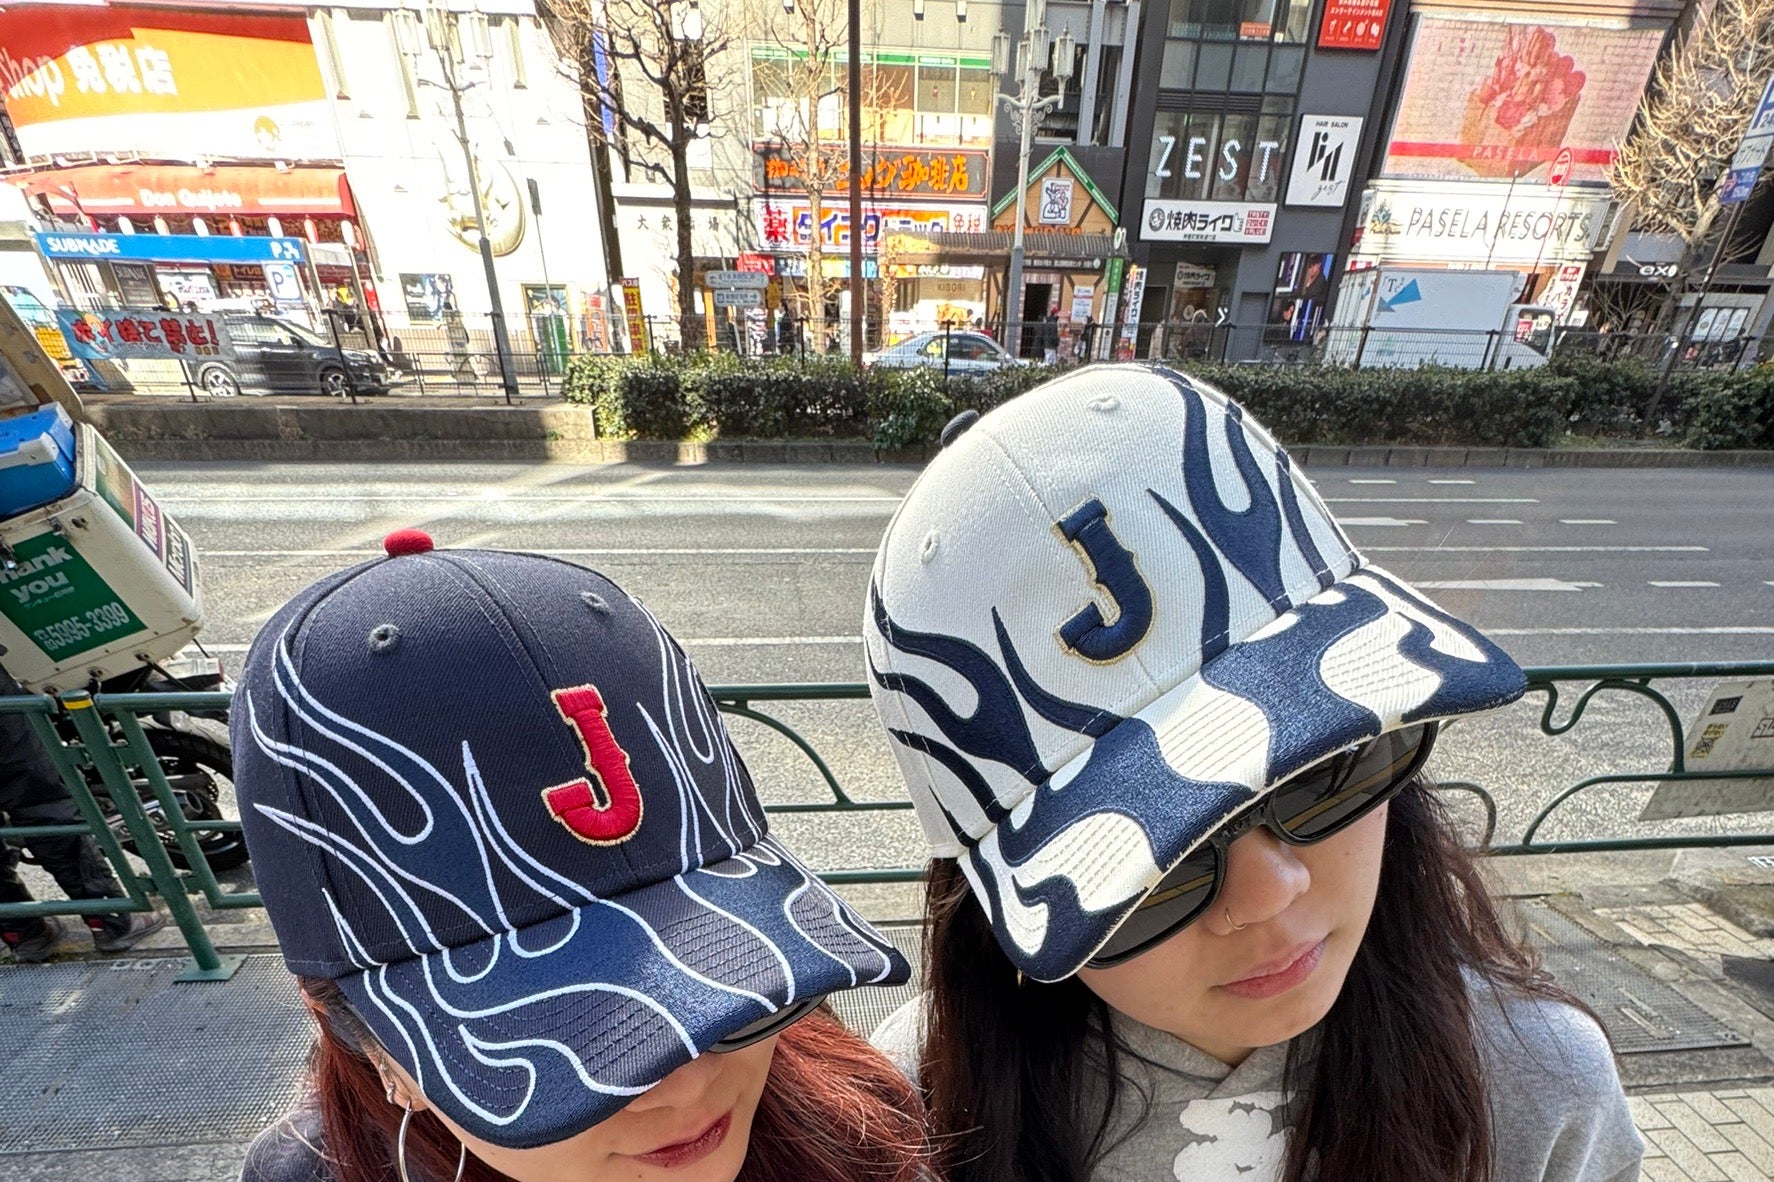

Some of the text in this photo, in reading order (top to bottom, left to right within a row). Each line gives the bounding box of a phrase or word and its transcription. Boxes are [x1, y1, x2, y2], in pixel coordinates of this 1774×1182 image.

[1154, 135, 1279, 182] ZEST
[1472, 146, 1539, 160] PASELA
[637, 213, 720, 232] 大衆場
[1165, 210, 1234, 232] 焼肉ライク
[1406, 206, 1591, 243] PASELA RESORTS
[271, 271, 285, 294] P
[10, 571, 70, 604] you
[1051, 494, 1155, 666] J
[541, 683, 643, 846] J
